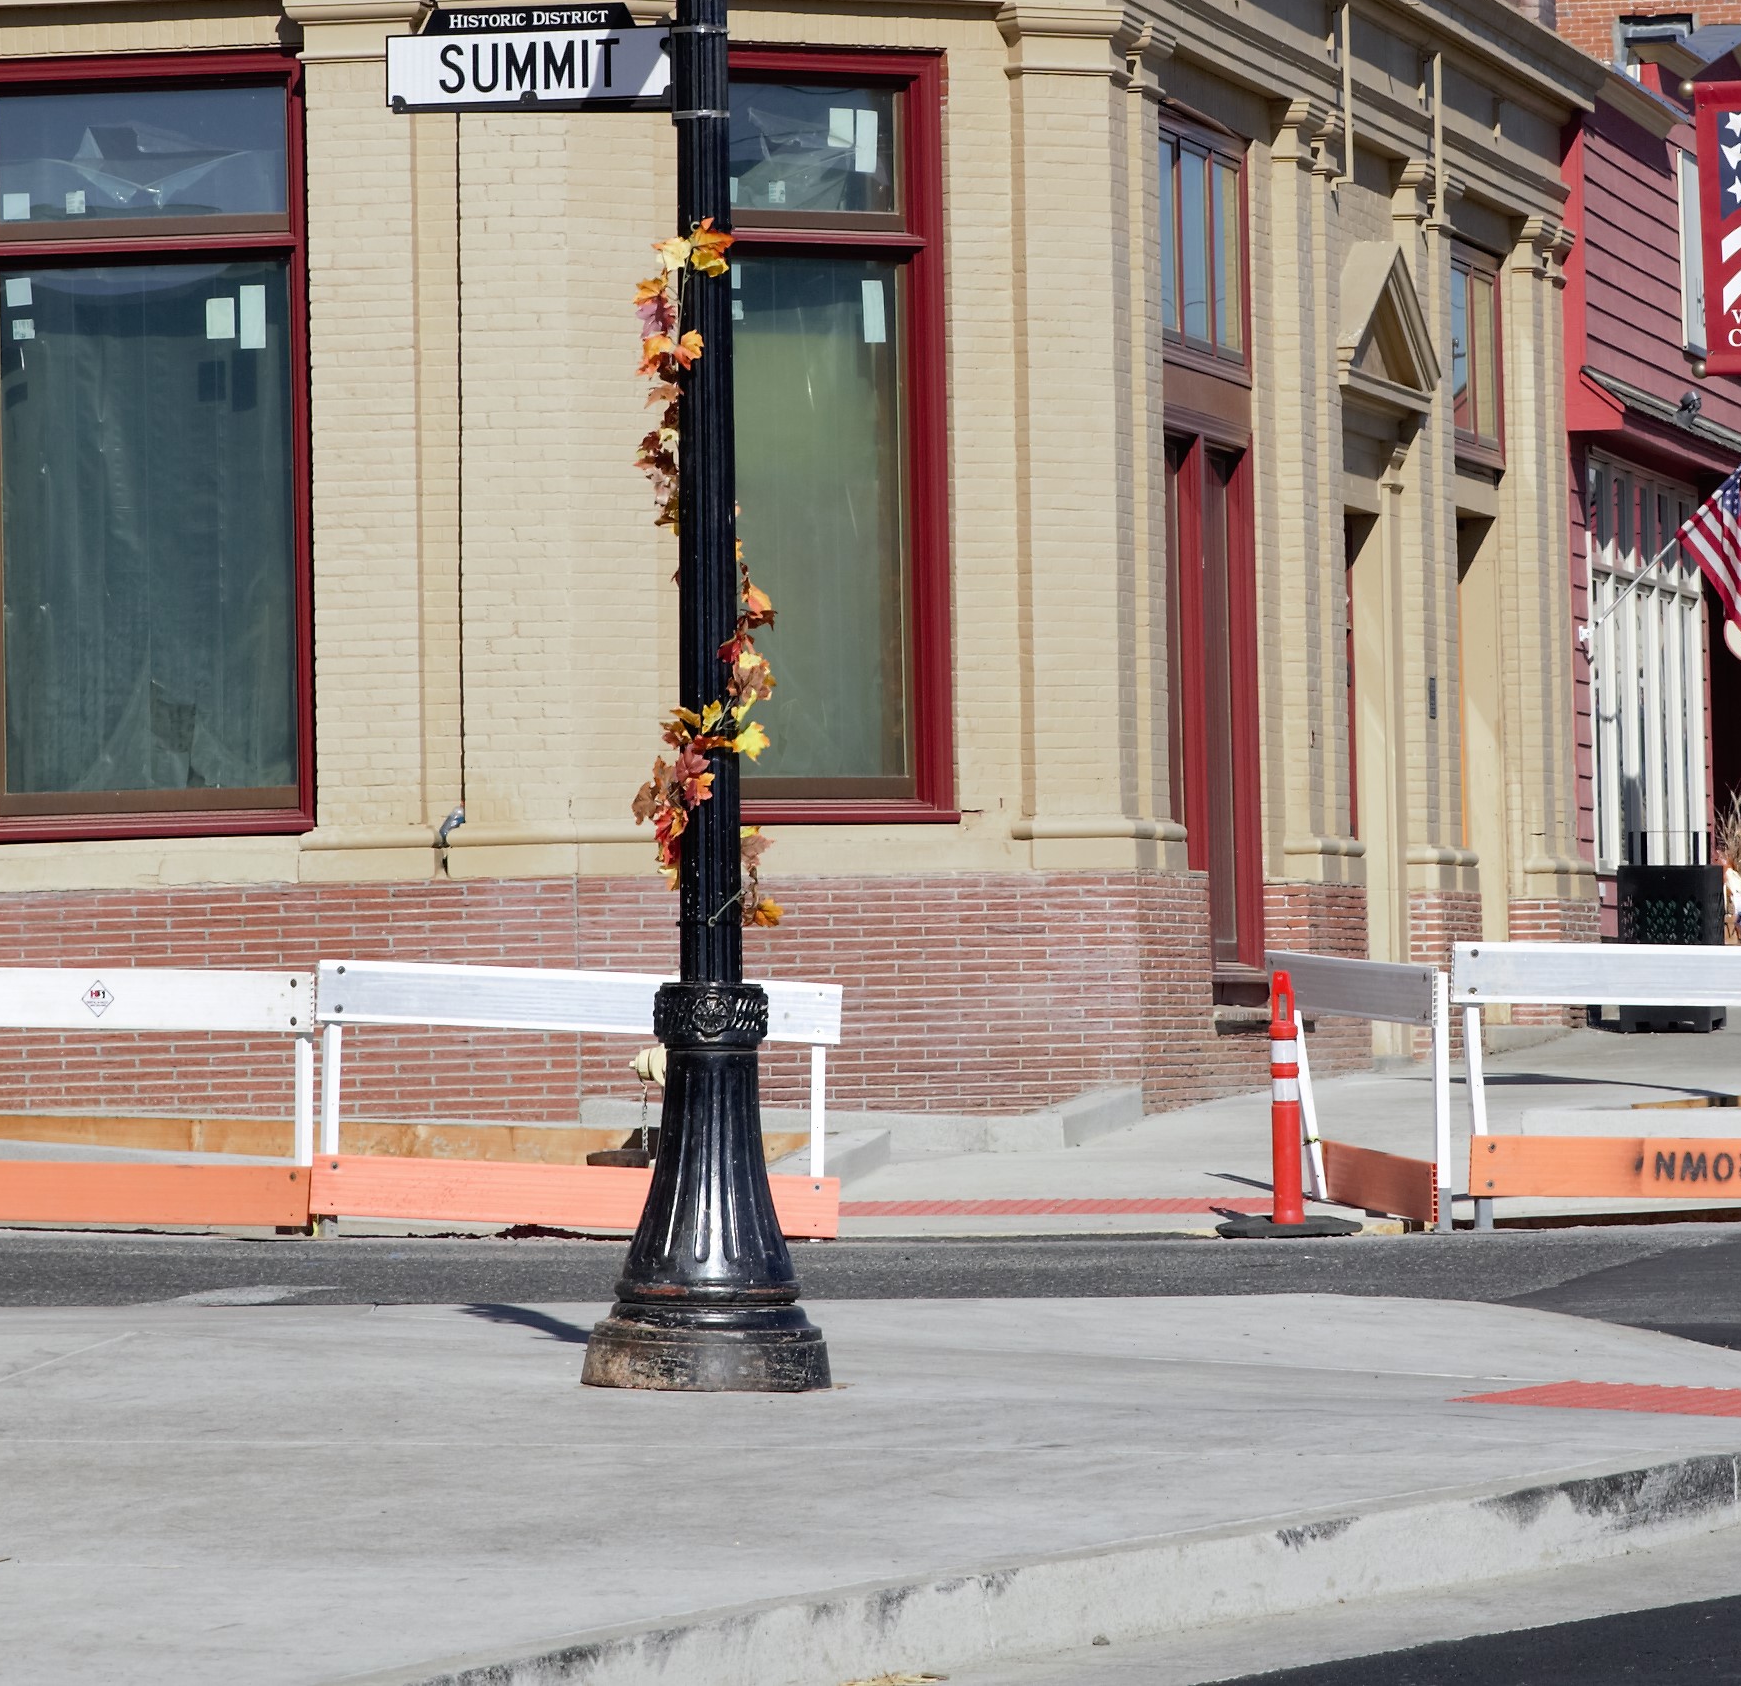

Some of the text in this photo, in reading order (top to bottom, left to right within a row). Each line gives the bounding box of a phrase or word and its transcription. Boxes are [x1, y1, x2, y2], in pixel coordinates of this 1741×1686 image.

[449, 9, 608, 29] HISTORIC DISTRICT
[439, 38, 620, 94] SUMMIT
